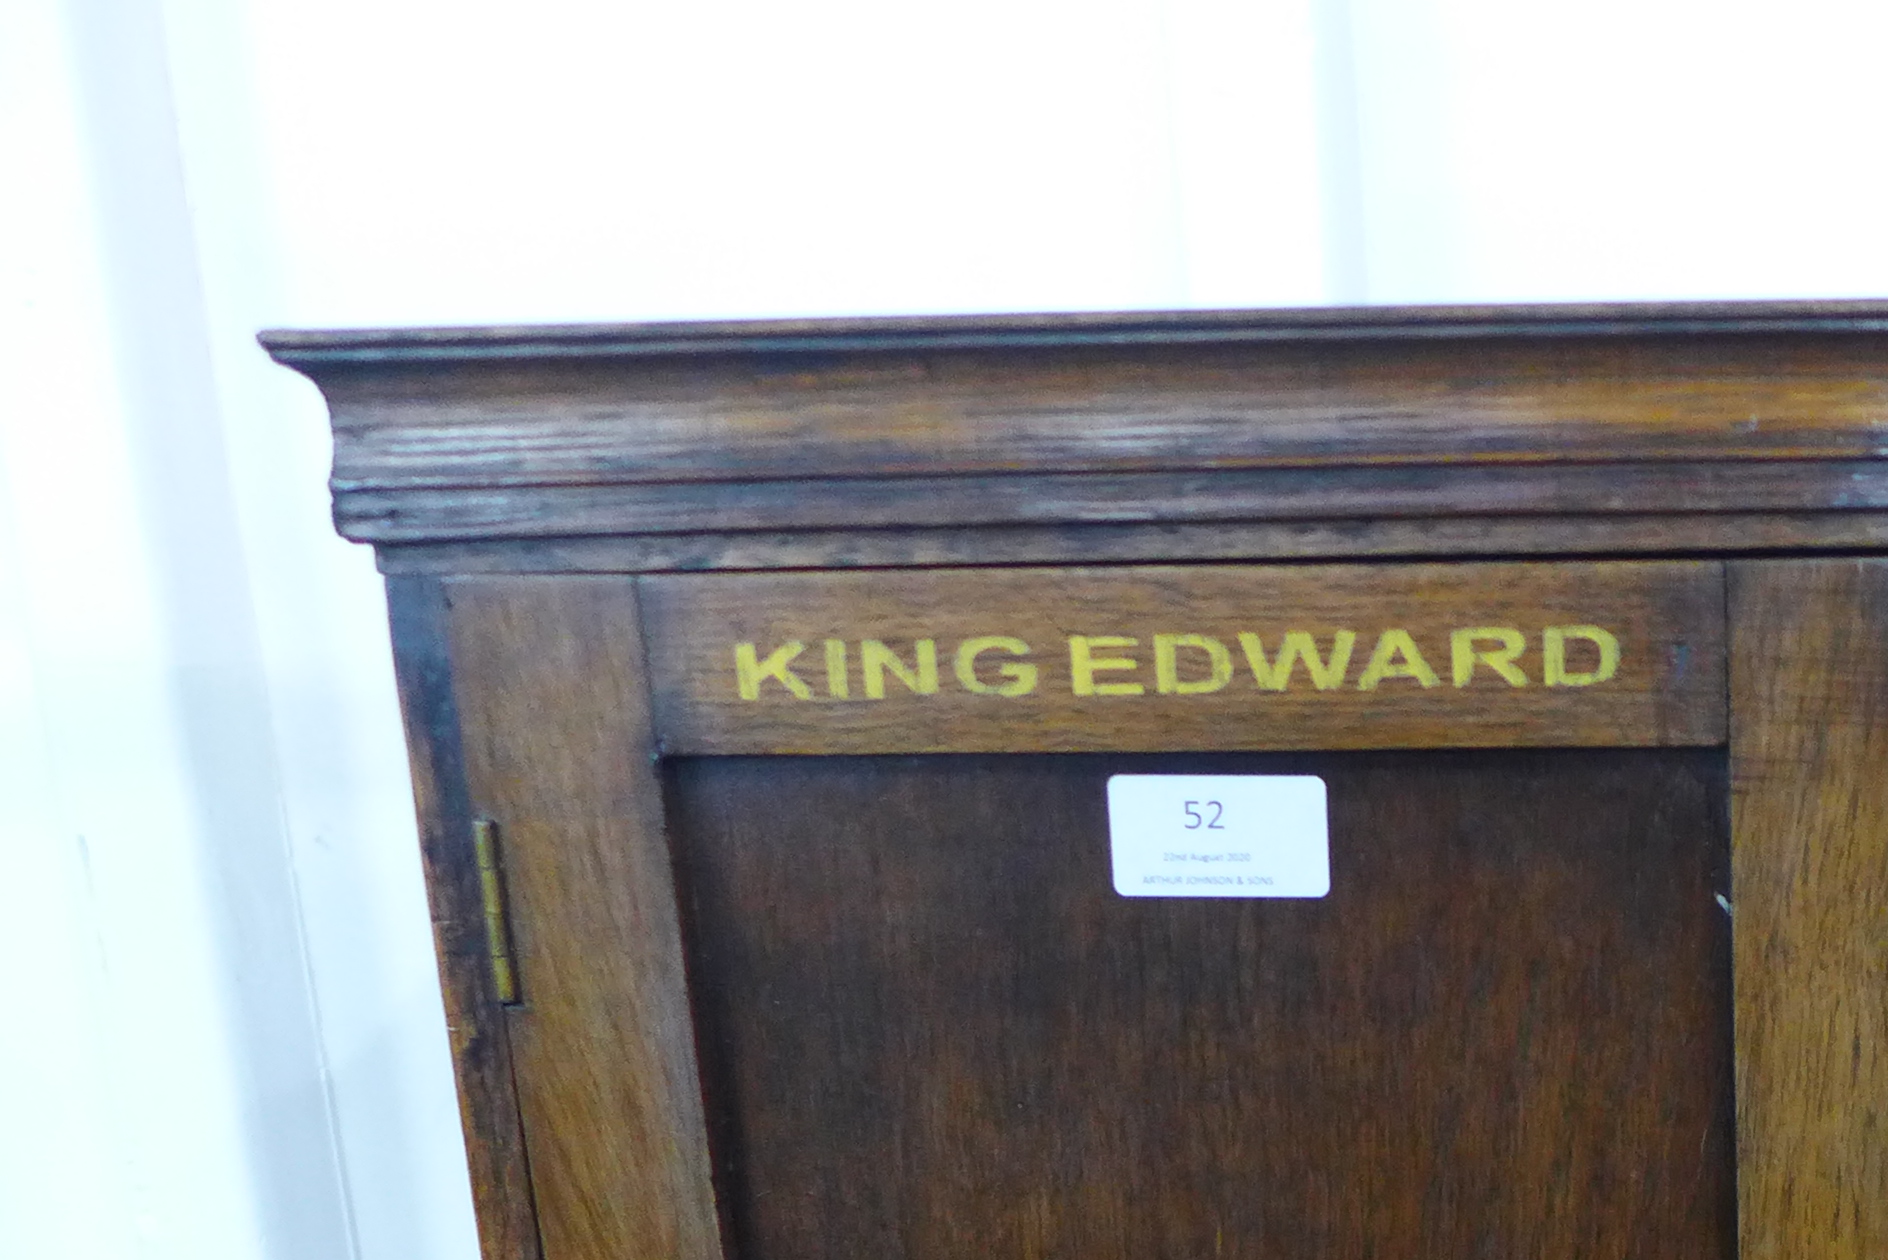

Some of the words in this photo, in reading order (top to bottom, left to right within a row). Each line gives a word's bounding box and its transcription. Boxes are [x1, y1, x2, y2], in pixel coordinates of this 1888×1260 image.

[734, 634, 1036, 702] KING
[1068, 624, 1622, 697] EDWARD
[1184, 800, 1225, 829] 52
[1190, 852, 1223, 863] August
[1227, 852, 1251, 862] 2020
[1143, 876, 1183, 885] ARTHUR
[1186, 876, 1233, 885] JOHNSON
[1236, 876, 1244, 885] &
[1247, 876, 1274, 885] SONS
